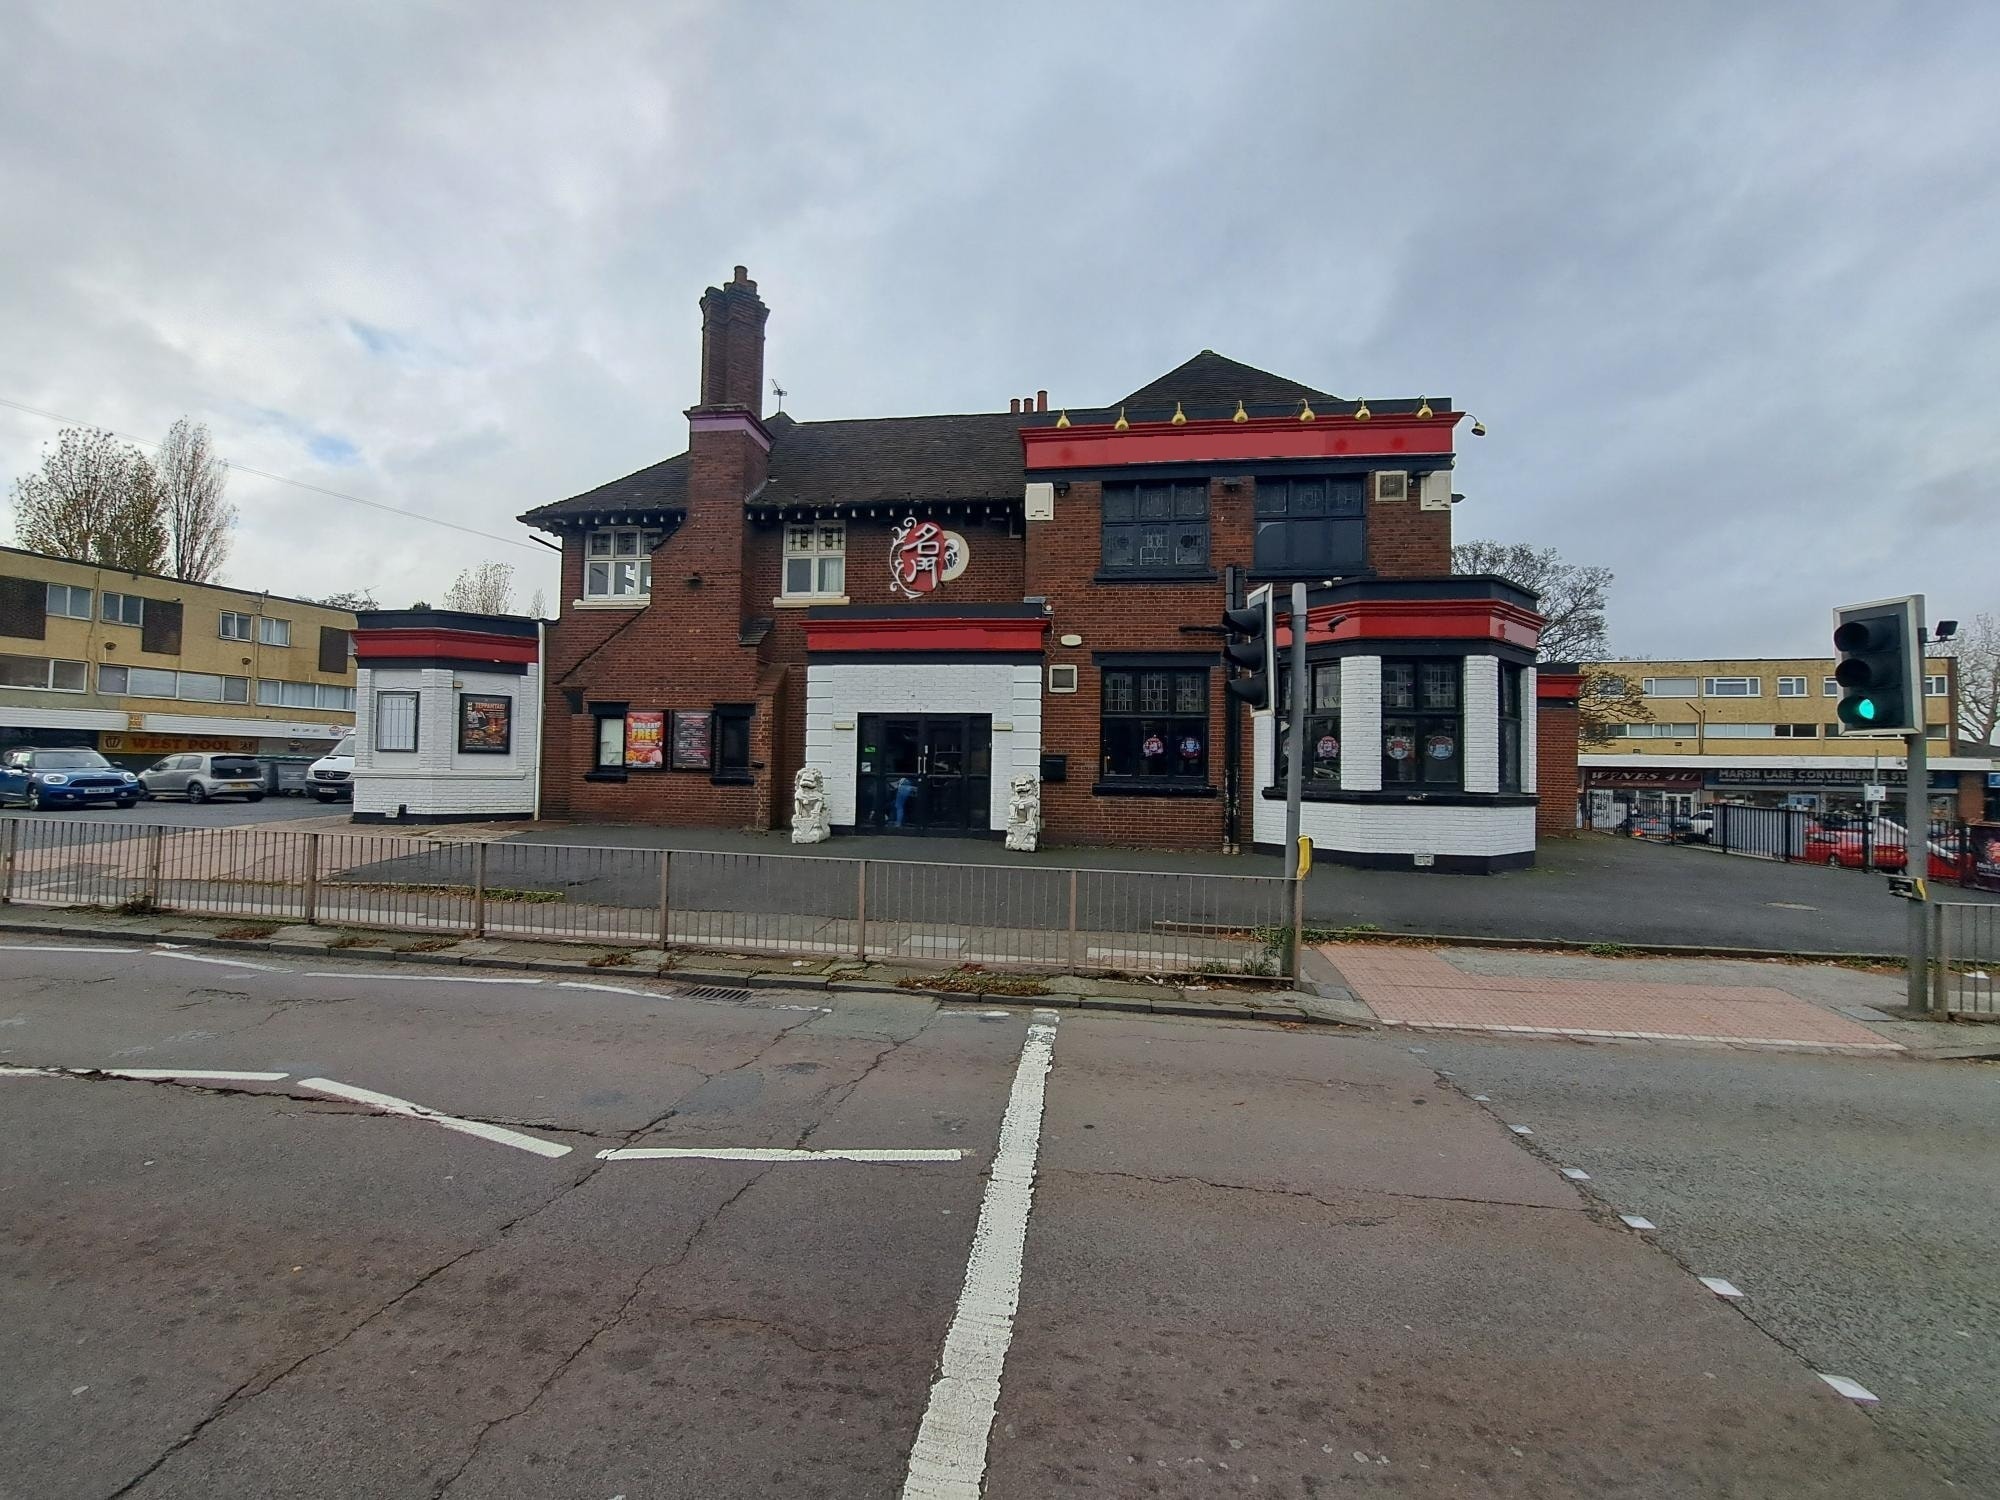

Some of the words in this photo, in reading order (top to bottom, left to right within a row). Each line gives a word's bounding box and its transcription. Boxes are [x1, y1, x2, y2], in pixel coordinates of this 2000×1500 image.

[631, 728, 658, 740] FREE
[132, 737, 183, 749] WEST
[188, 739, 232, 750] POOL
[1591, 771, 1660, 780] WINES
[1718, 769, 1760, 779] MARSH
[1763, 770, 1794, 779] LANE
[1890, 771, 1934, 780] STE
